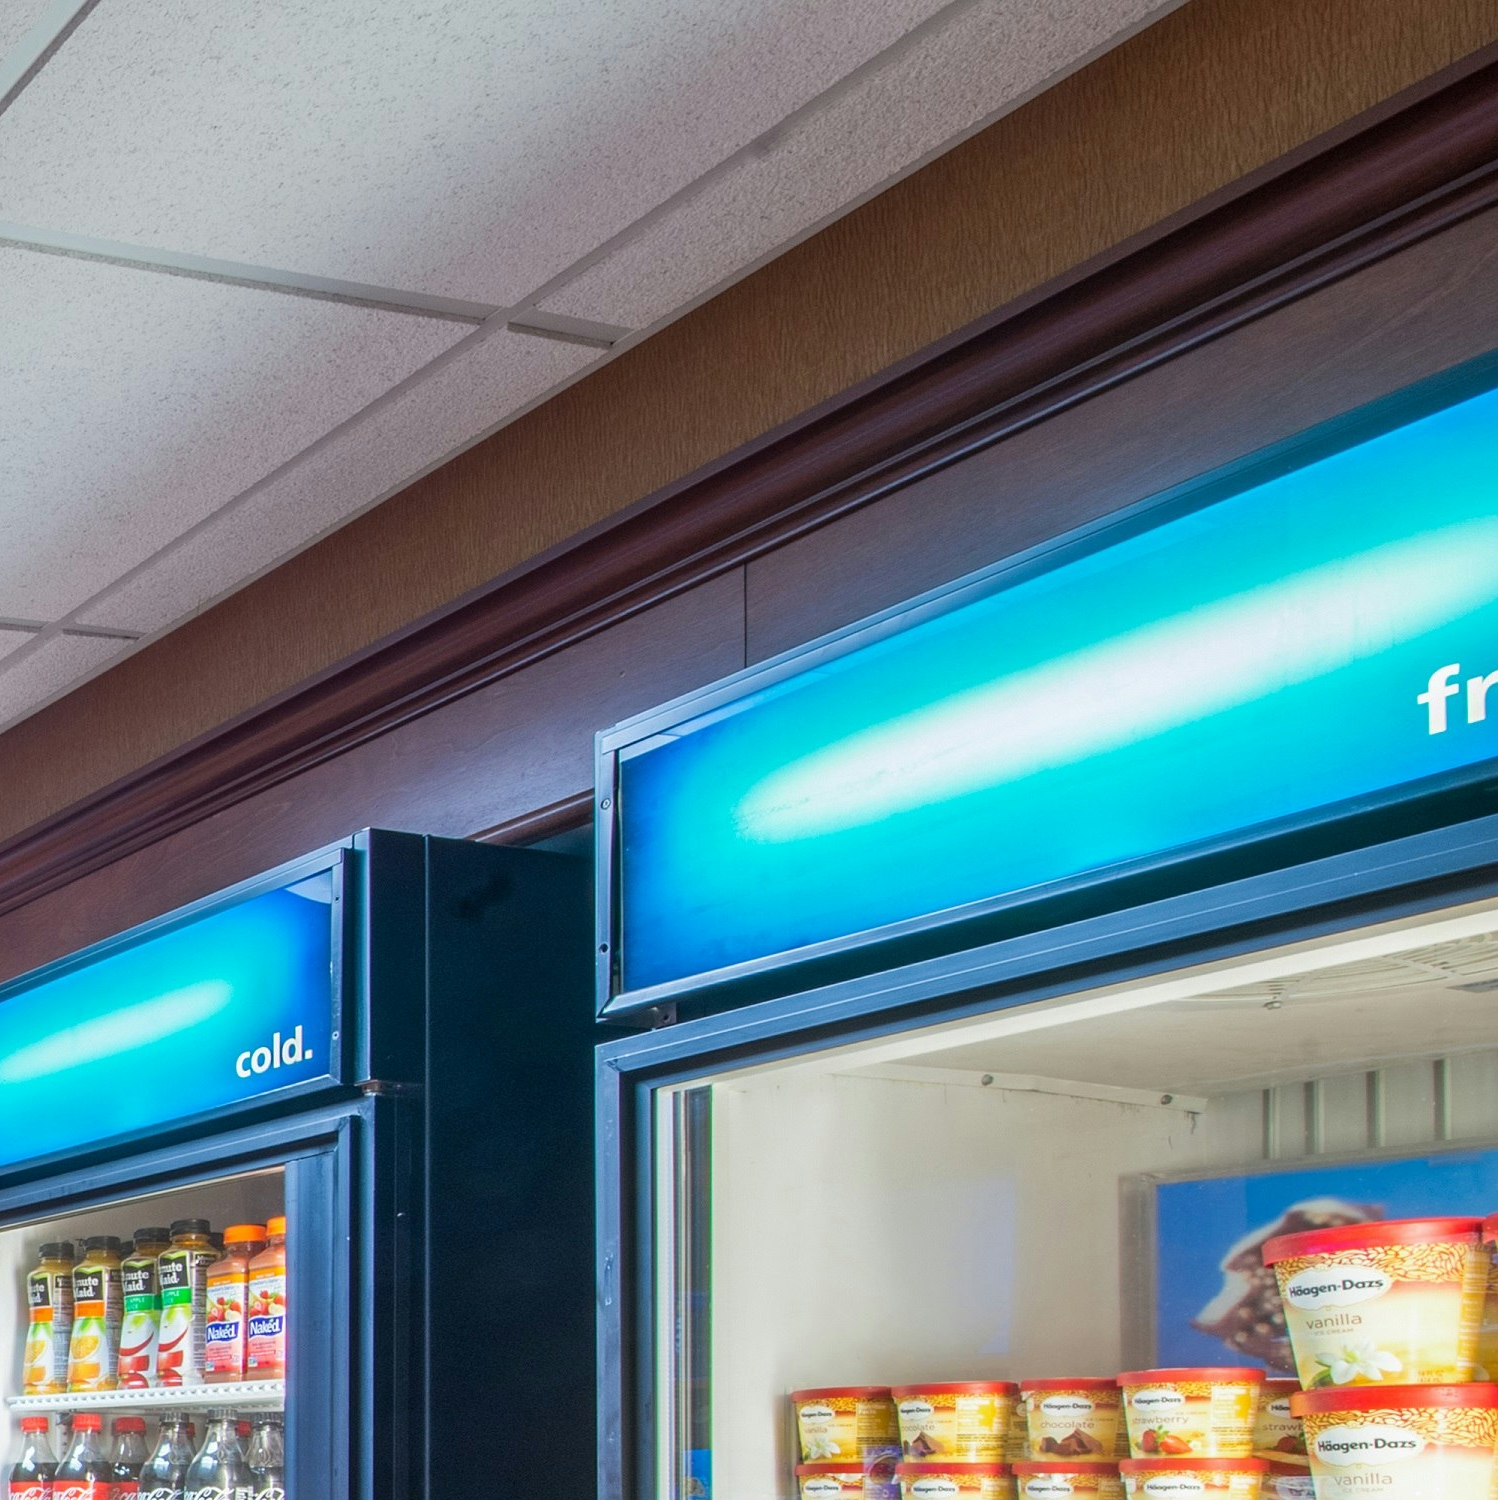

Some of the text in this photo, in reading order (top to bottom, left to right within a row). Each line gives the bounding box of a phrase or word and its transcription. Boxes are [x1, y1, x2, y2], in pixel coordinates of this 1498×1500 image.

[236, 1024, 313, 1078] cold.
[1289, 1277, 1384, 1298] Häagen-Dazs
[249, 1319, 281, 1336] Naked
[1306, 1314, 1363, 1330] vanilla
[207, 1324, 237, 1340] Naked
[1043, 1402, 1092, 1412] Häagen-Dazs
[1040, 1420, 1095, 1429] chocolate
[1132, 1415, 1188, 1426] strawberry
[1317, 1439, 1417, 1452] Häagen-Dazs
[1334, 1473, 1393, 1486] vanilla
